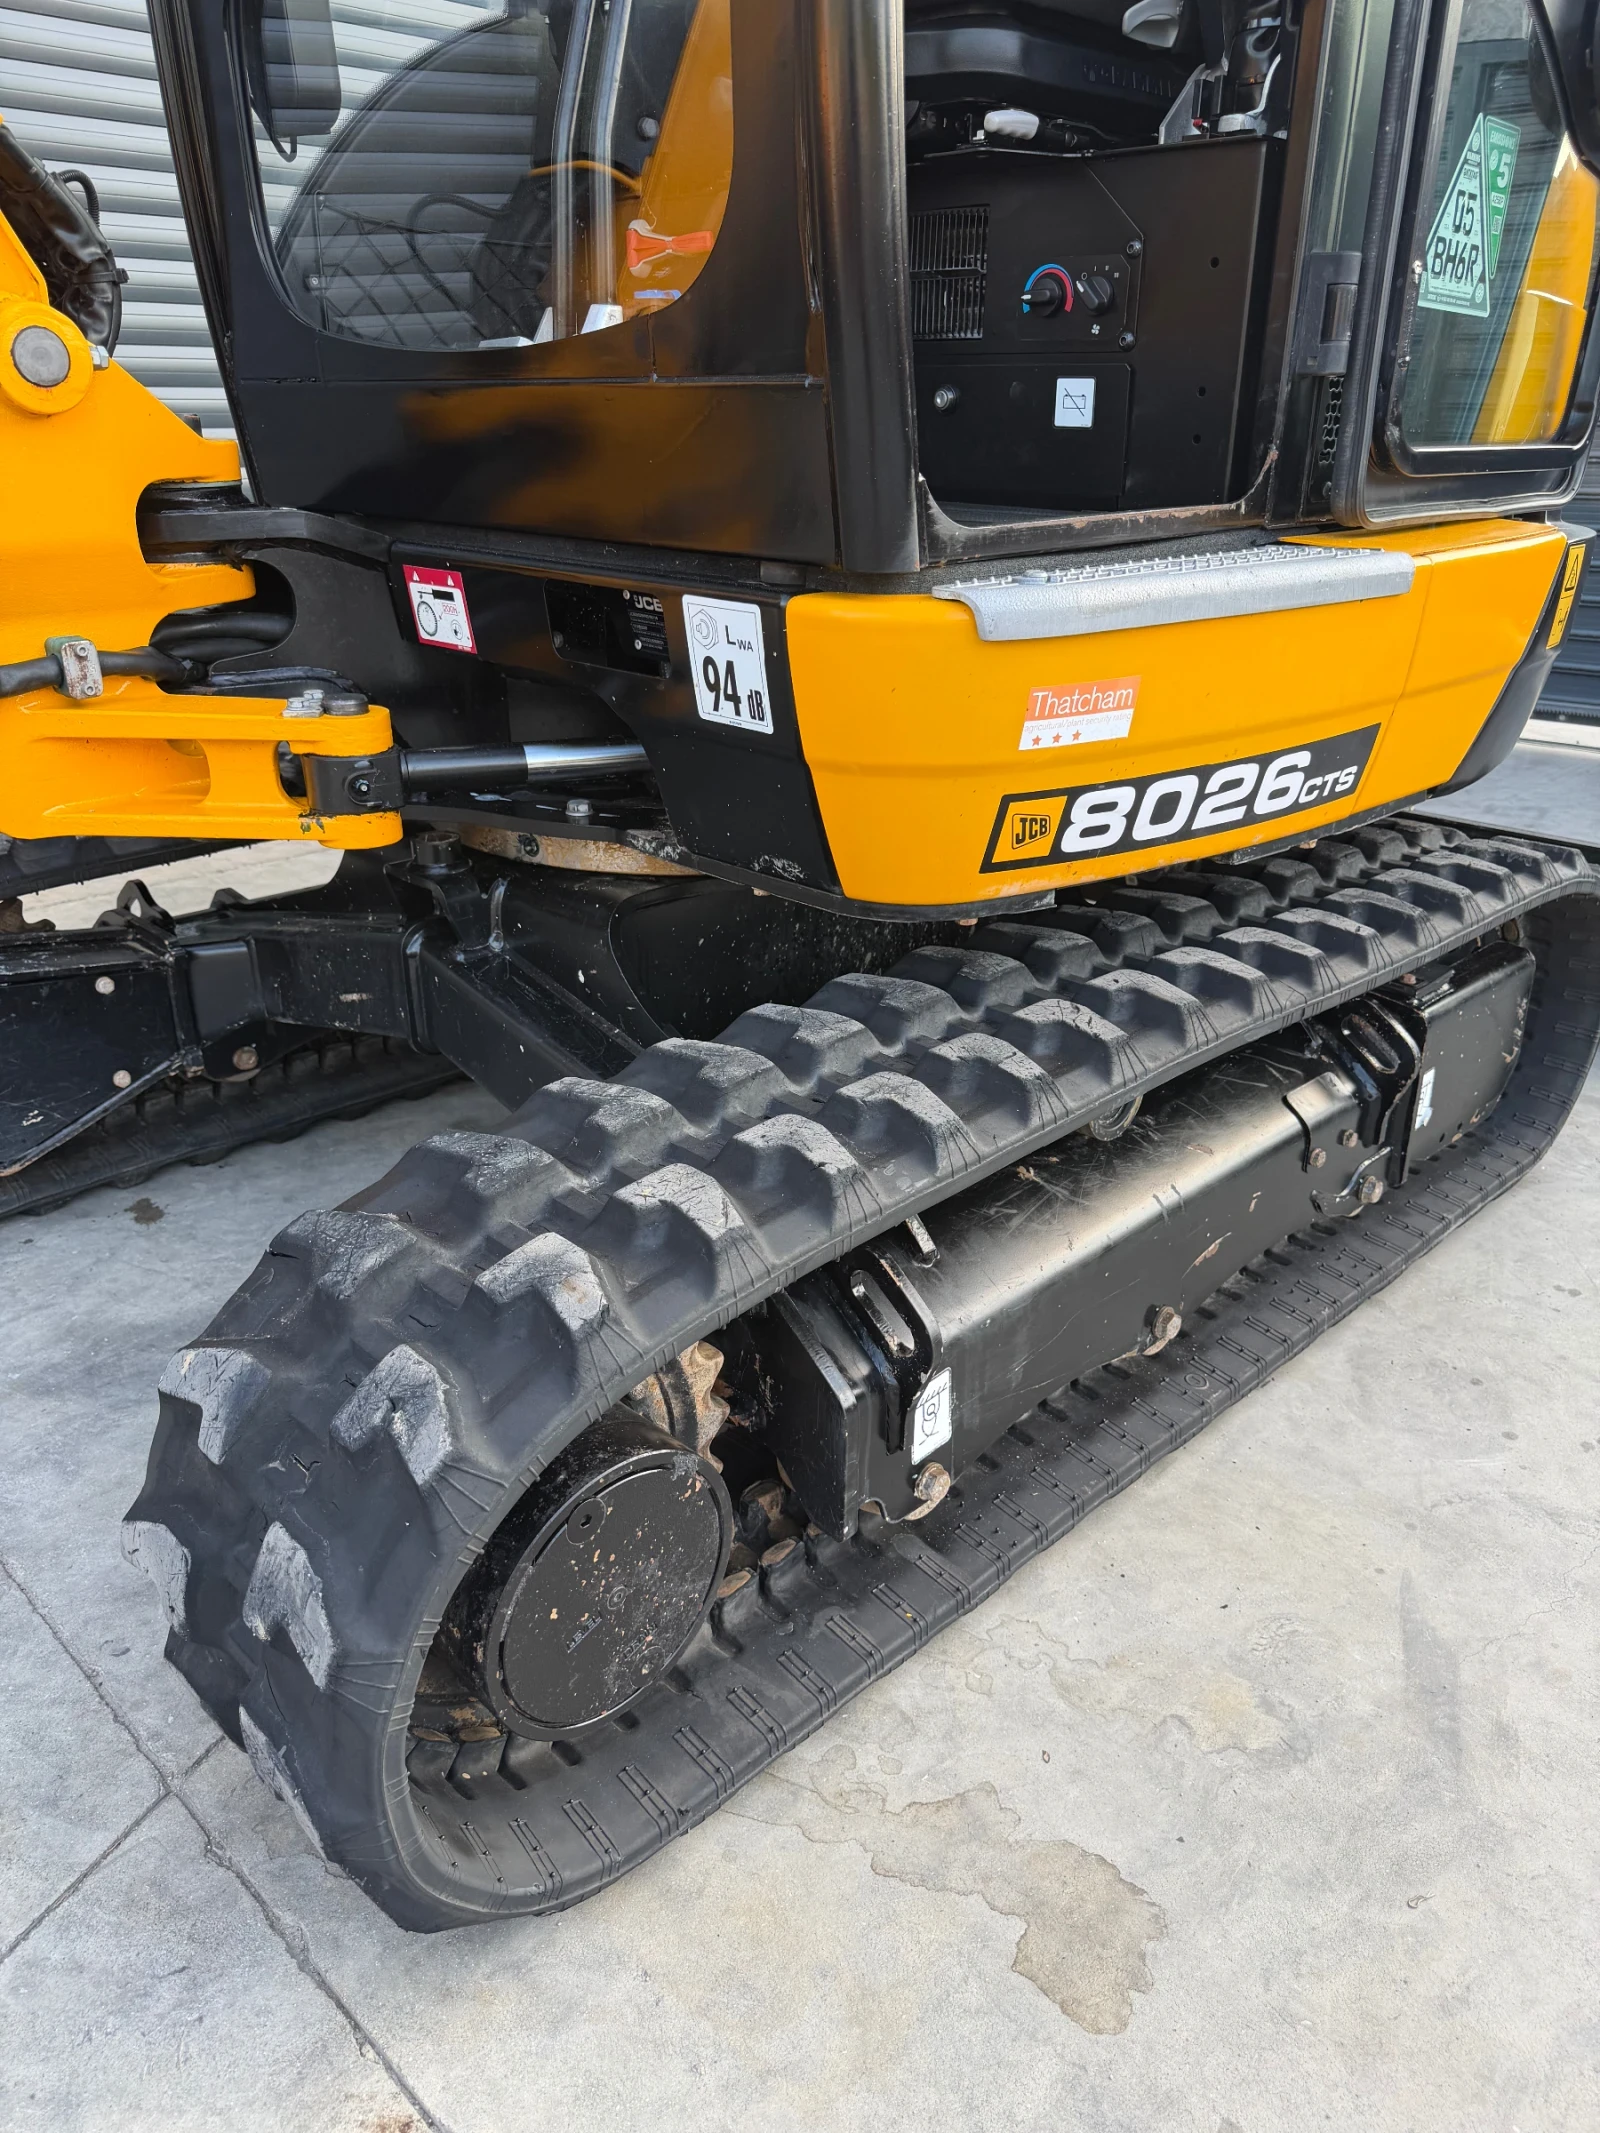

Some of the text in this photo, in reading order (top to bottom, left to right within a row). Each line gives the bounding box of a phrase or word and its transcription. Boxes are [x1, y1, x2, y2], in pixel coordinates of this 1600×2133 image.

[1496, 153, 1512, 189] 5
[1431, 236, 1480, 288] BH6R
[702, 655, 765, 722] 94 dB
[1032, 686, 1133, 717] Thatcham
[1015, 817, 1048, 845] JCB
